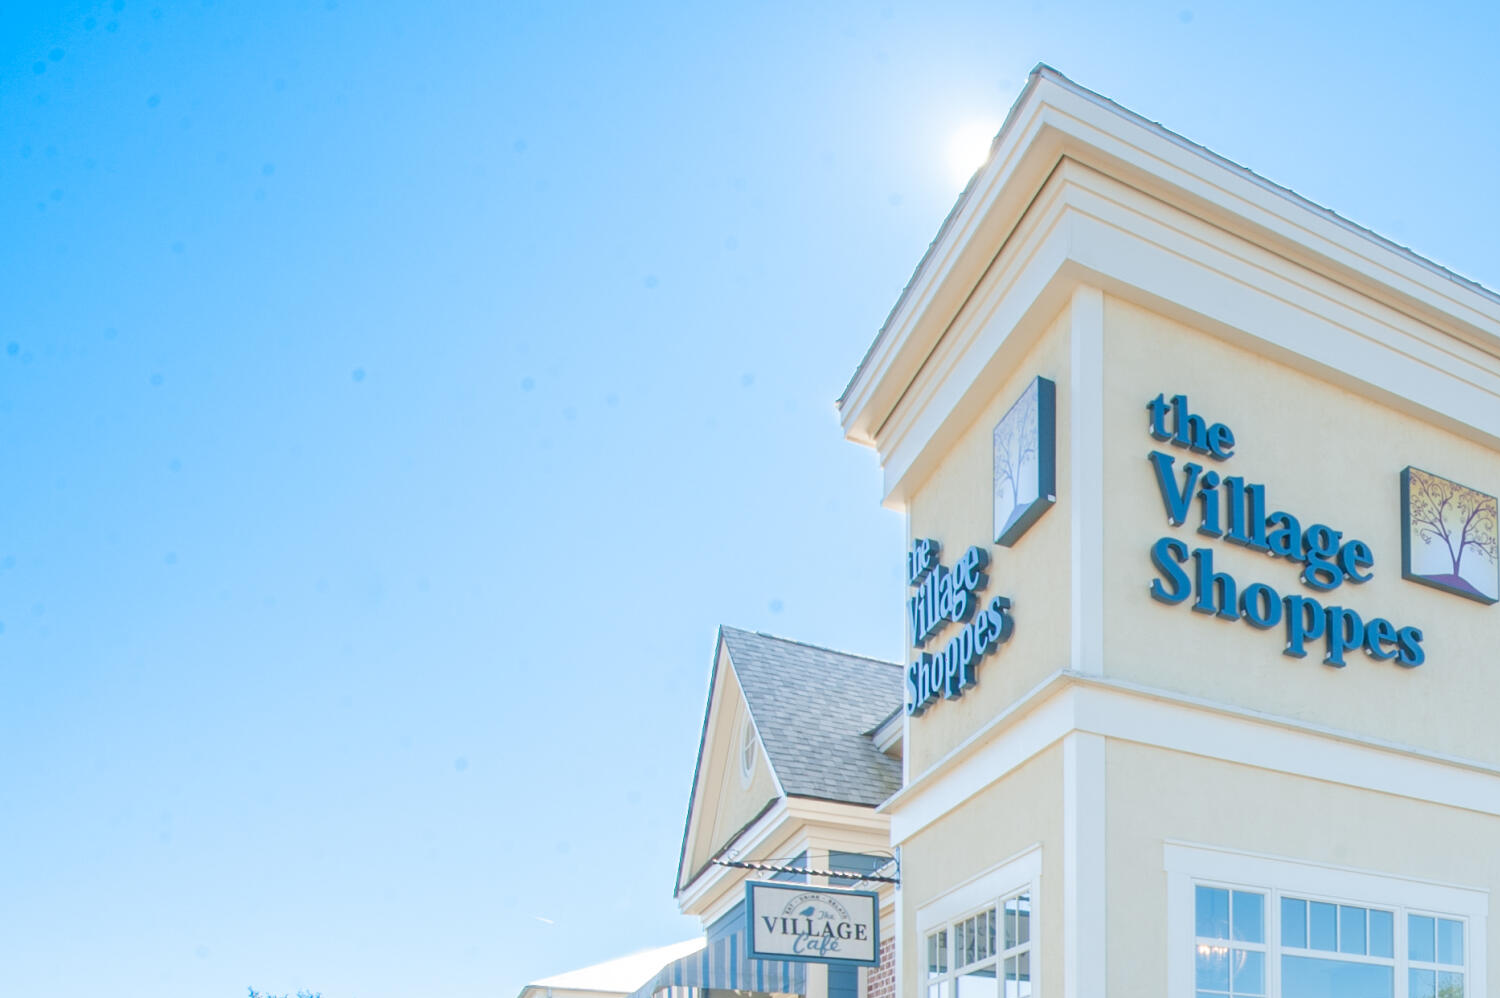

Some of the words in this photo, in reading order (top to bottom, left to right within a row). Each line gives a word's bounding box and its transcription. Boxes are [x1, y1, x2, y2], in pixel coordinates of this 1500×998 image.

[1148, 394, 1235, 461] the
[1149, 451, 1374, 591] Village
[907, 545, 988, 648] Village
[1150, 537, 1424, 668] Shoppes
[907, 595, 1013, 717] Shoppes
[762, 915, 868, 941] VILLAGE
[793, 932, 841, 957] Café
